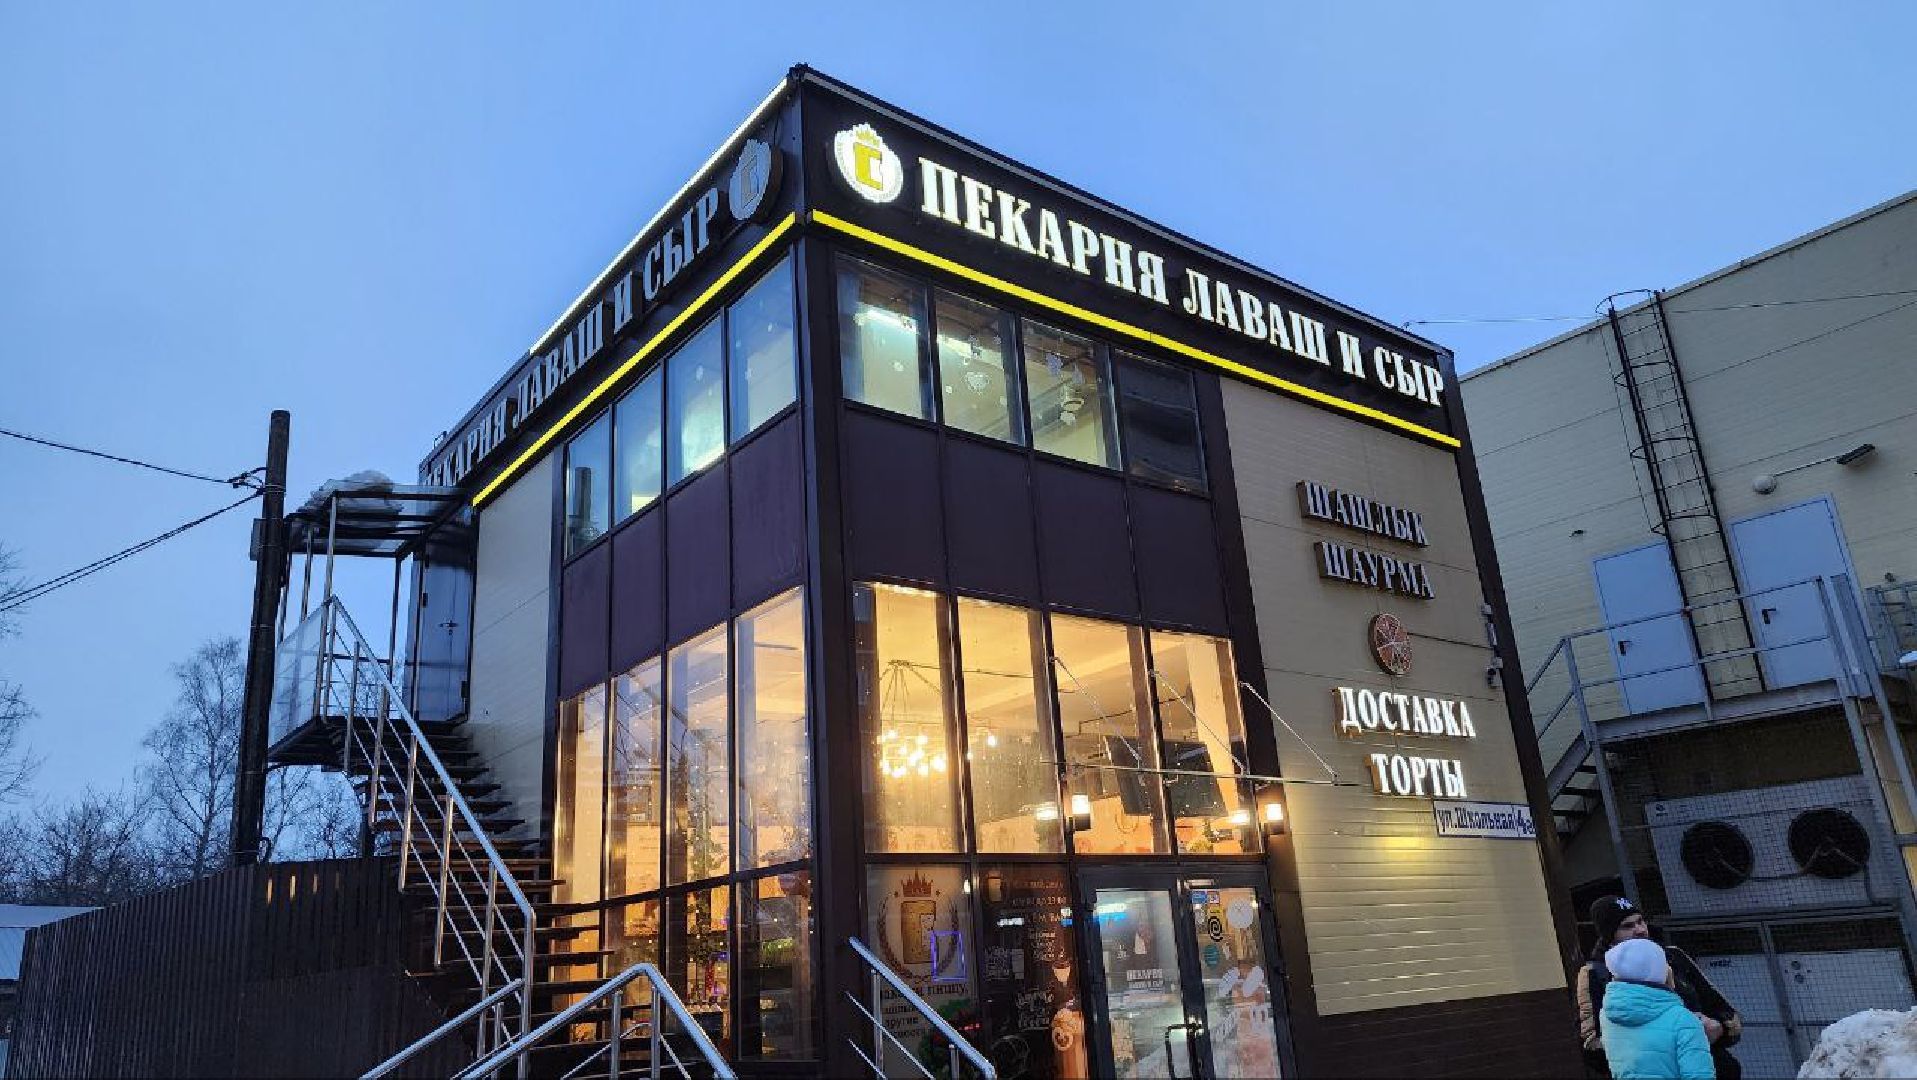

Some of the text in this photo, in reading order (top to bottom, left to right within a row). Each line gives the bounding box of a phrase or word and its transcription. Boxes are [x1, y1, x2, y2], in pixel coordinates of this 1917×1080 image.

[512, 299, 605, 428] ЛАВАШ
[613, 270, 634, 336] И
[643, 187, 720, 301] СЫР
[918, 155, 1446, 408] ПЕКАРНЯ ЛАВАШ И СЫР
[1302, 480, 1430, 548] ШАШЛЫК
[1320, 541, 1435, 600] ШАУРМА
[1336, 686, 1477, 738] ДОСТАВКА
[1369, 753, 1467, 798] ТОРТЫ
